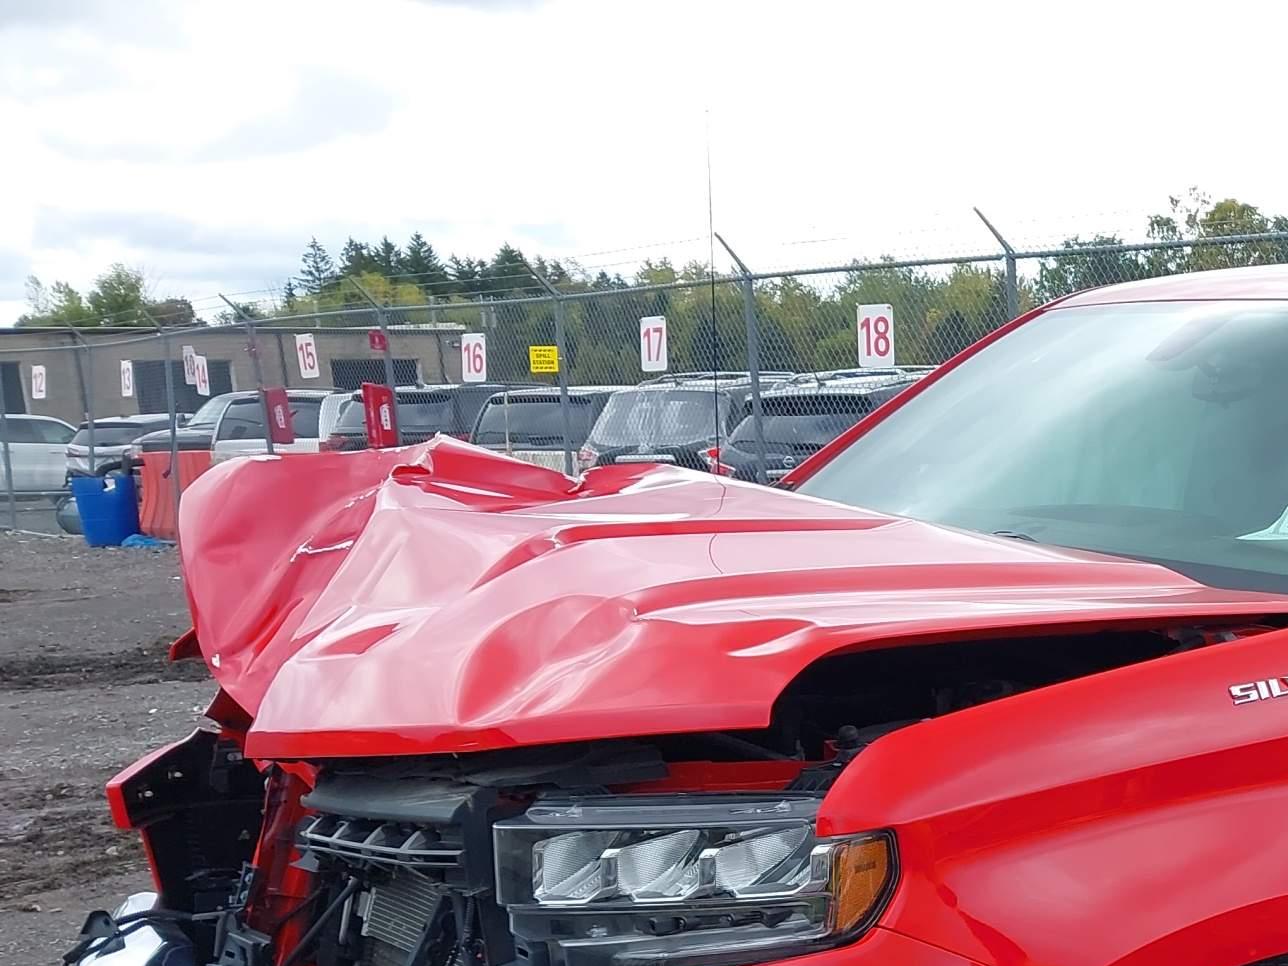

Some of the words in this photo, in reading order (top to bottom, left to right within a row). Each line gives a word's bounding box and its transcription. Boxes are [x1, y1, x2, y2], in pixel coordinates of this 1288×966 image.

[643, 326, 664, 362] 17
[860, 316, 891, 357] 18
[298, 342, 316, 371] 15
[464, 342, 484, 374] 16
[33, 372, 44, 393] 12
[196, 363, 207, 388] 14
